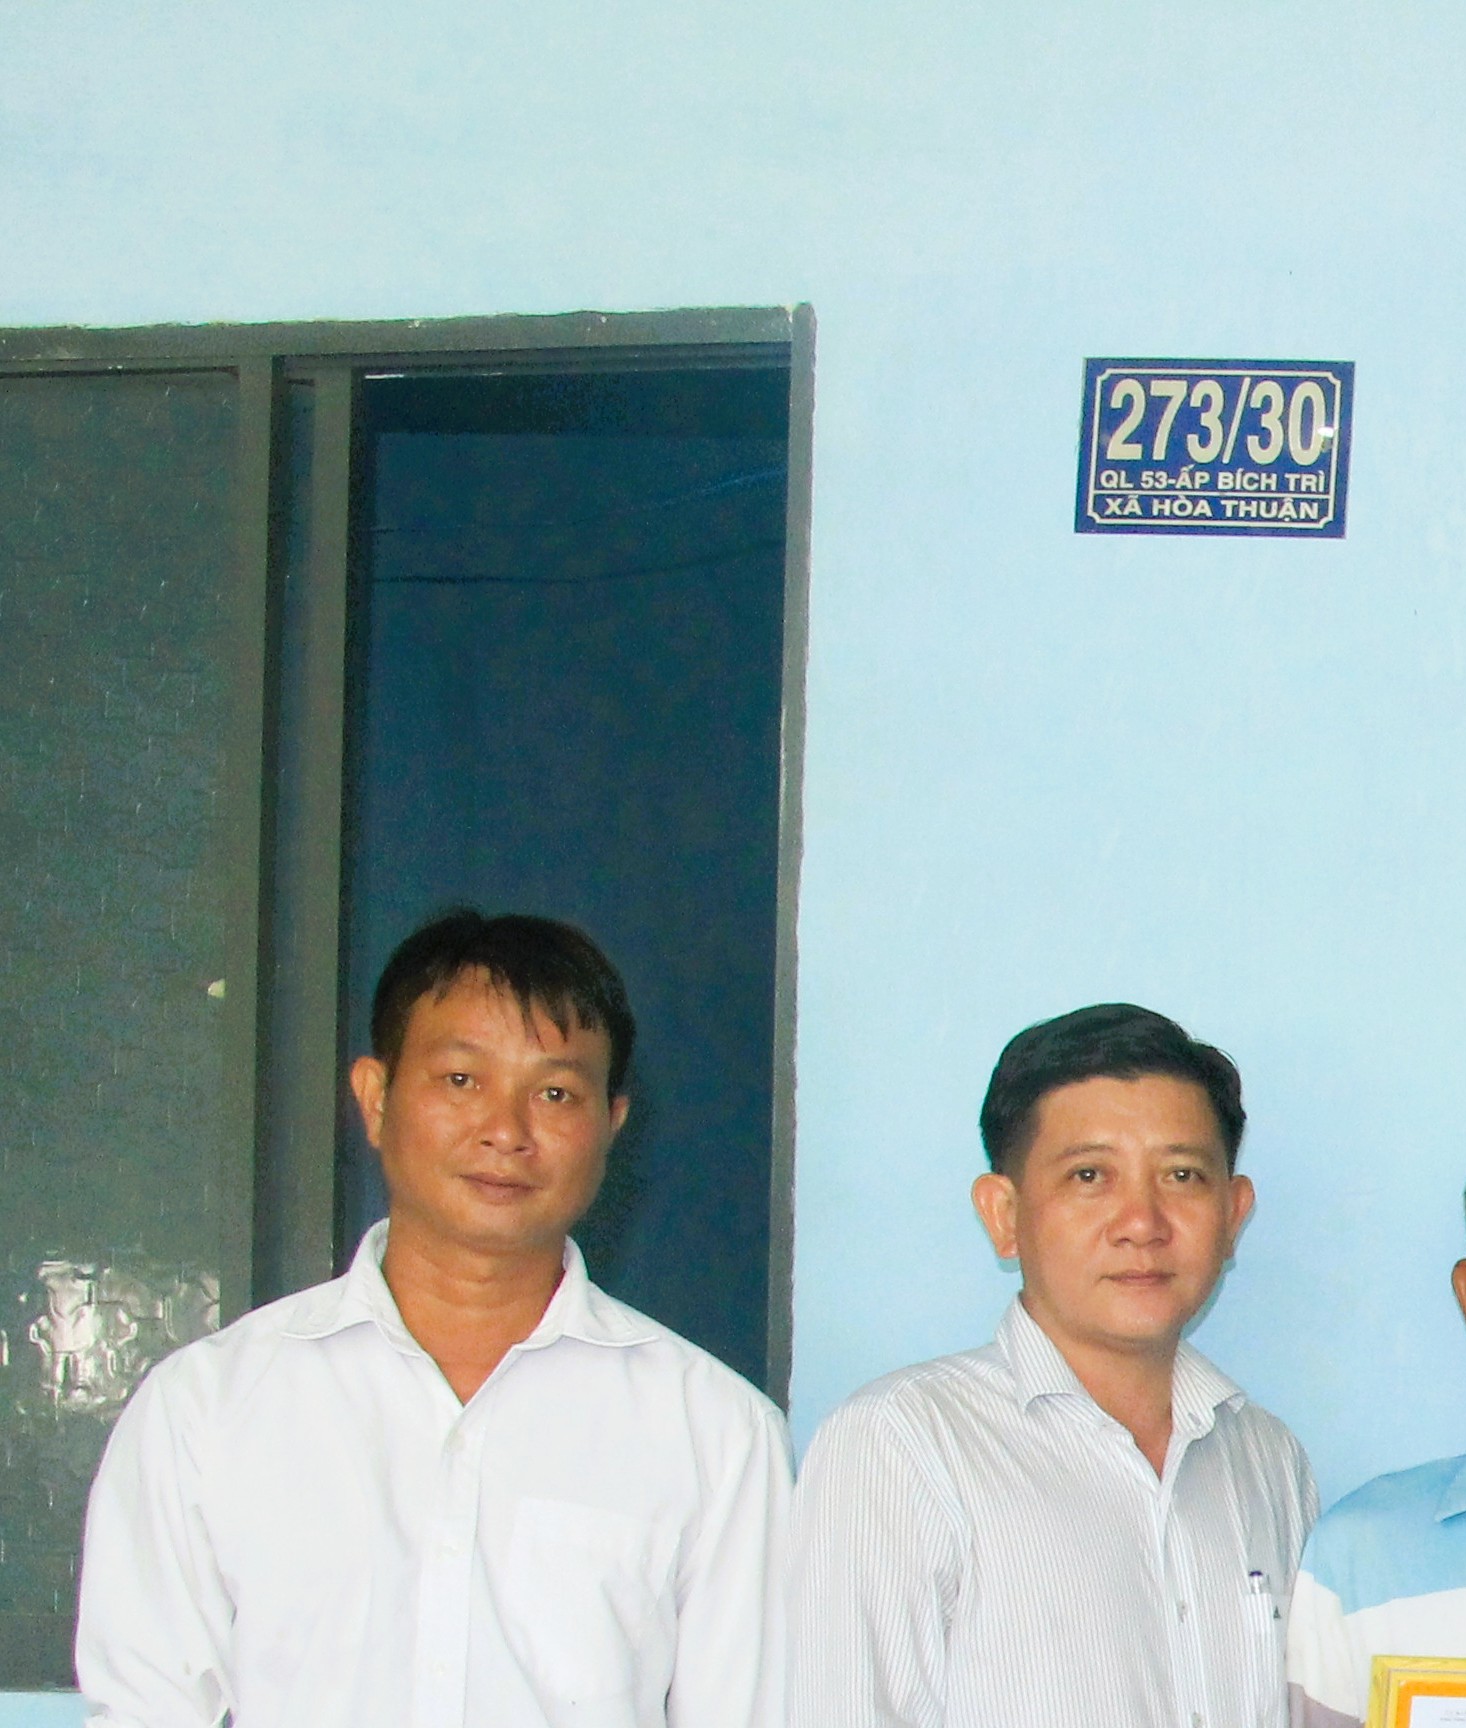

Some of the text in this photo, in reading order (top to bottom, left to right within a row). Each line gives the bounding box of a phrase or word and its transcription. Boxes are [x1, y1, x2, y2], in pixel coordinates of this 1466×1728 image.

[1105, 376, 1327, 467] 273/30
[1100, 463, 1326, 493] QL 53-ẤP BÍCH TRÌ
[1105, 494, 1319, 523] XÃ HÒA THUẬN
